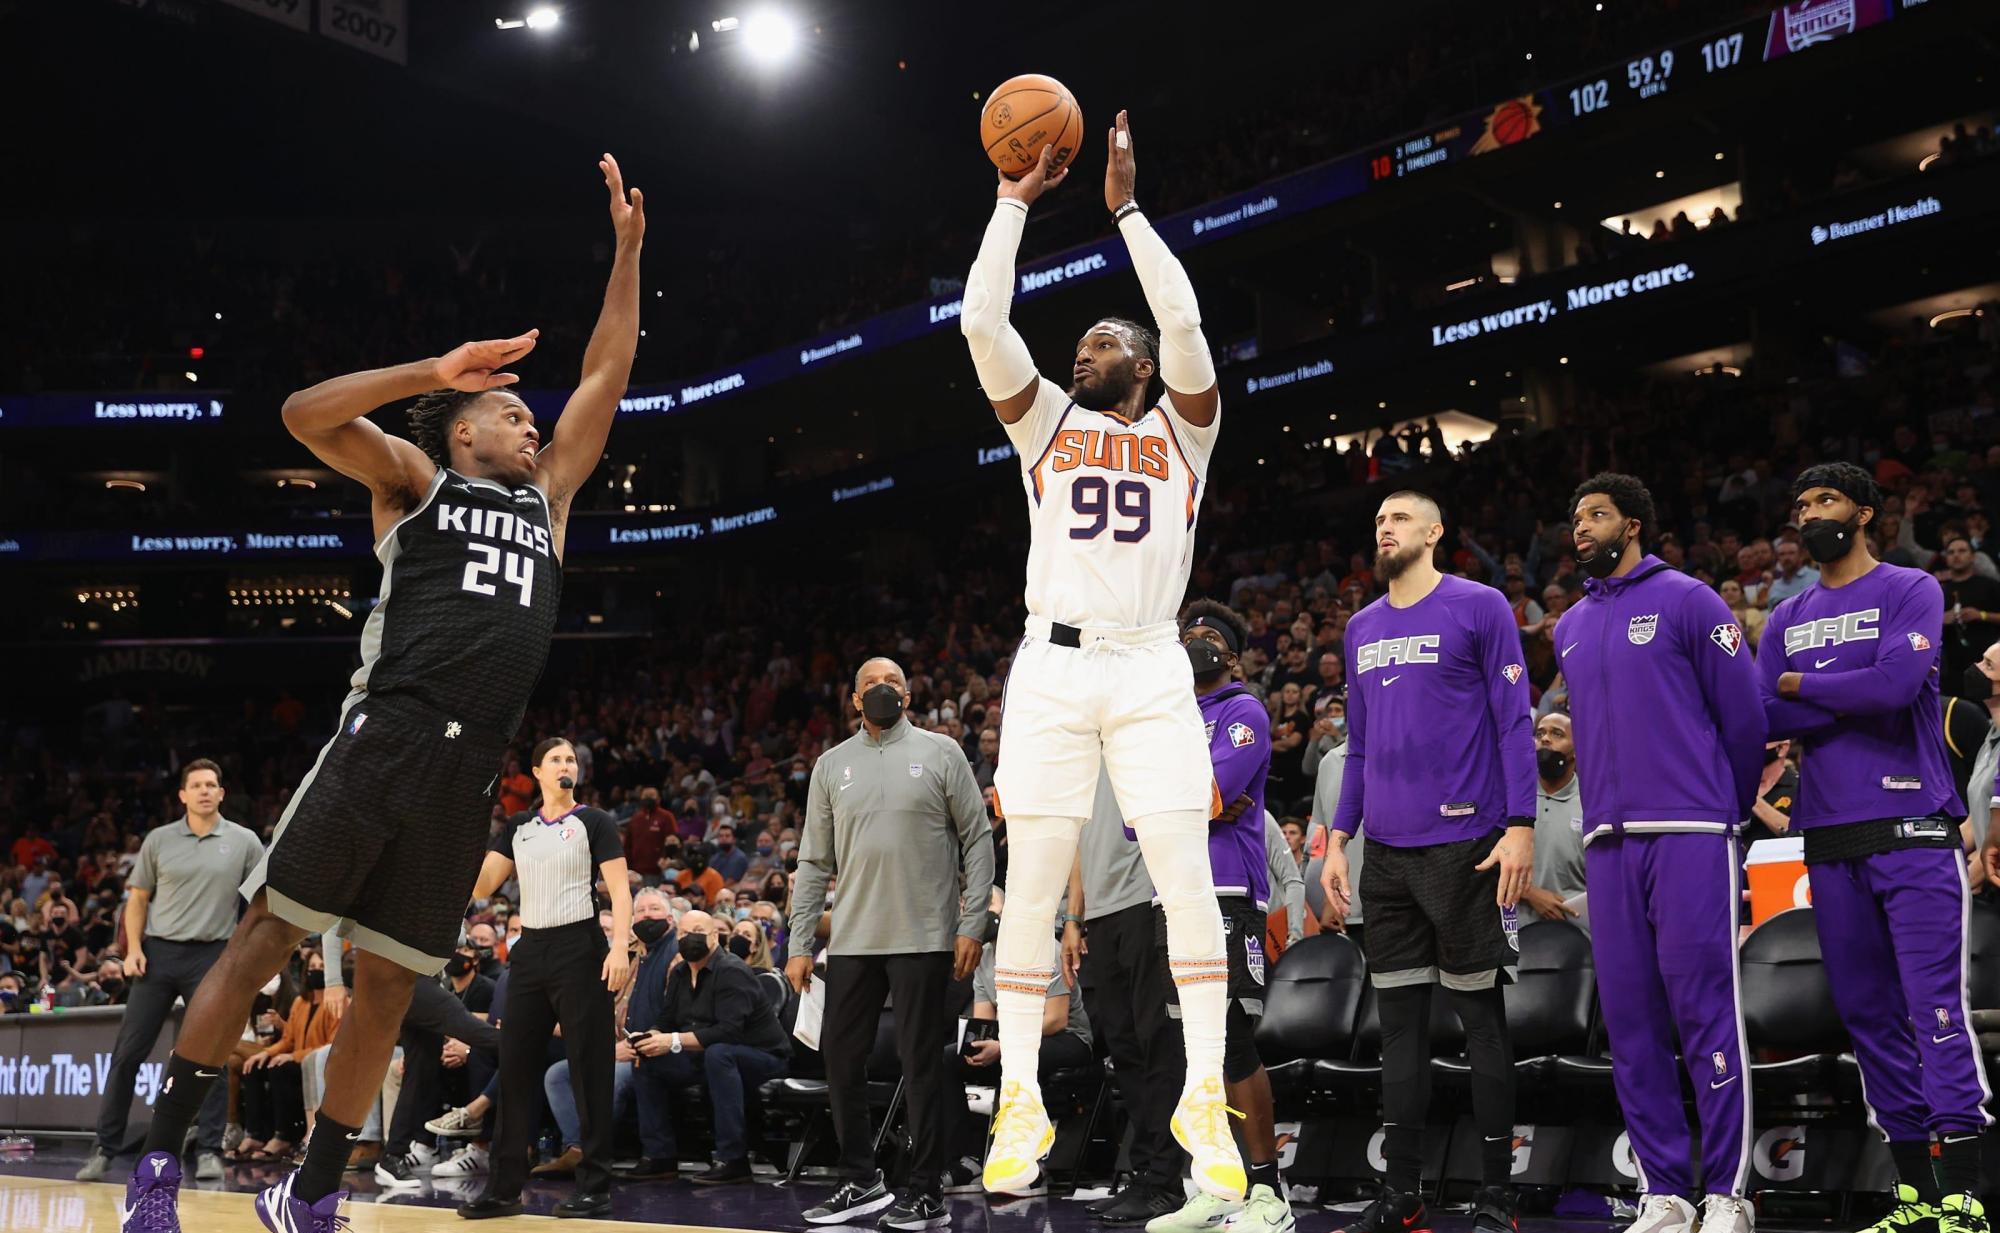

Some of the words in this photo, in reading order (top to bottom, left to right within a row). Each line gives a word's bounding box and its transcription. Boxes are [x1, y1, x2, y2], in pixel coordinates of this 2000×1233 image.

[332, 6, 397, 48] 2007
[1627, 50, 1674, 88] 59.9
[1702, 32, 1744, 72] 107
[1569, 79, 1609, 116] 102
[1405, 136, 1432, 155] FOULS
[1407, 147, 1447, 172] TIMEOUTS
[1372, 156, 1391, 179] 10
[1205, 209, 1241, 231] Banner
[1242, 196, 1278, 218] Health
[1829, 213, 1887, 239] Banner
[1887, 197, 1941, 224] Health
[1021, 262, 1064, 293] More
[1065, 252, 1107, 278] care.
[1432, 317, 1480, 346] Less
[1481, 299, 1557, 333] worry.
[1567, 279, 1629, 311] More
[1631, 262, 1695, 293] care.
[620, 394, 675, 411] worry.
[681, 383, 714, 405] More
[713, 373, 745, 394] care.
[1259, 371, 1296, 390] Banner
[1297, 360, 1334, 380] Health
[95, 401, 137, 418] Less
[139, 402, 202, 420] worry.
[978, 443, 1011, 465] Less
[1052, 430, 1168, 481] SUNS
[609, 527, 648, 543] Less
[650, 522, 704, 540] worry.
[711, 515, 745, 534] More
[747, 506, 777, 525] care.
[1069, 477, 1151, 544] 99
[132, 534, 174, 551] Less
[175, 536, 238, 552] worry.
[246, 533, 298, 549] More
[298, 534, 343, 548] care.
[437, 503, 550, 557] KINGS
[461, 542, 535, 608] 24
[1629, 625, 1655, 634] KINGS
[1785, 608, 1880, 657] SAC
[78, 648, 216, 682] JAMESON
[1357, 634, 1440, 675] SAC
[20, 1054, 50, 1096] for
[51, 1053, 92, 1096] The
[94, 1052, 163, 1106] Vey
